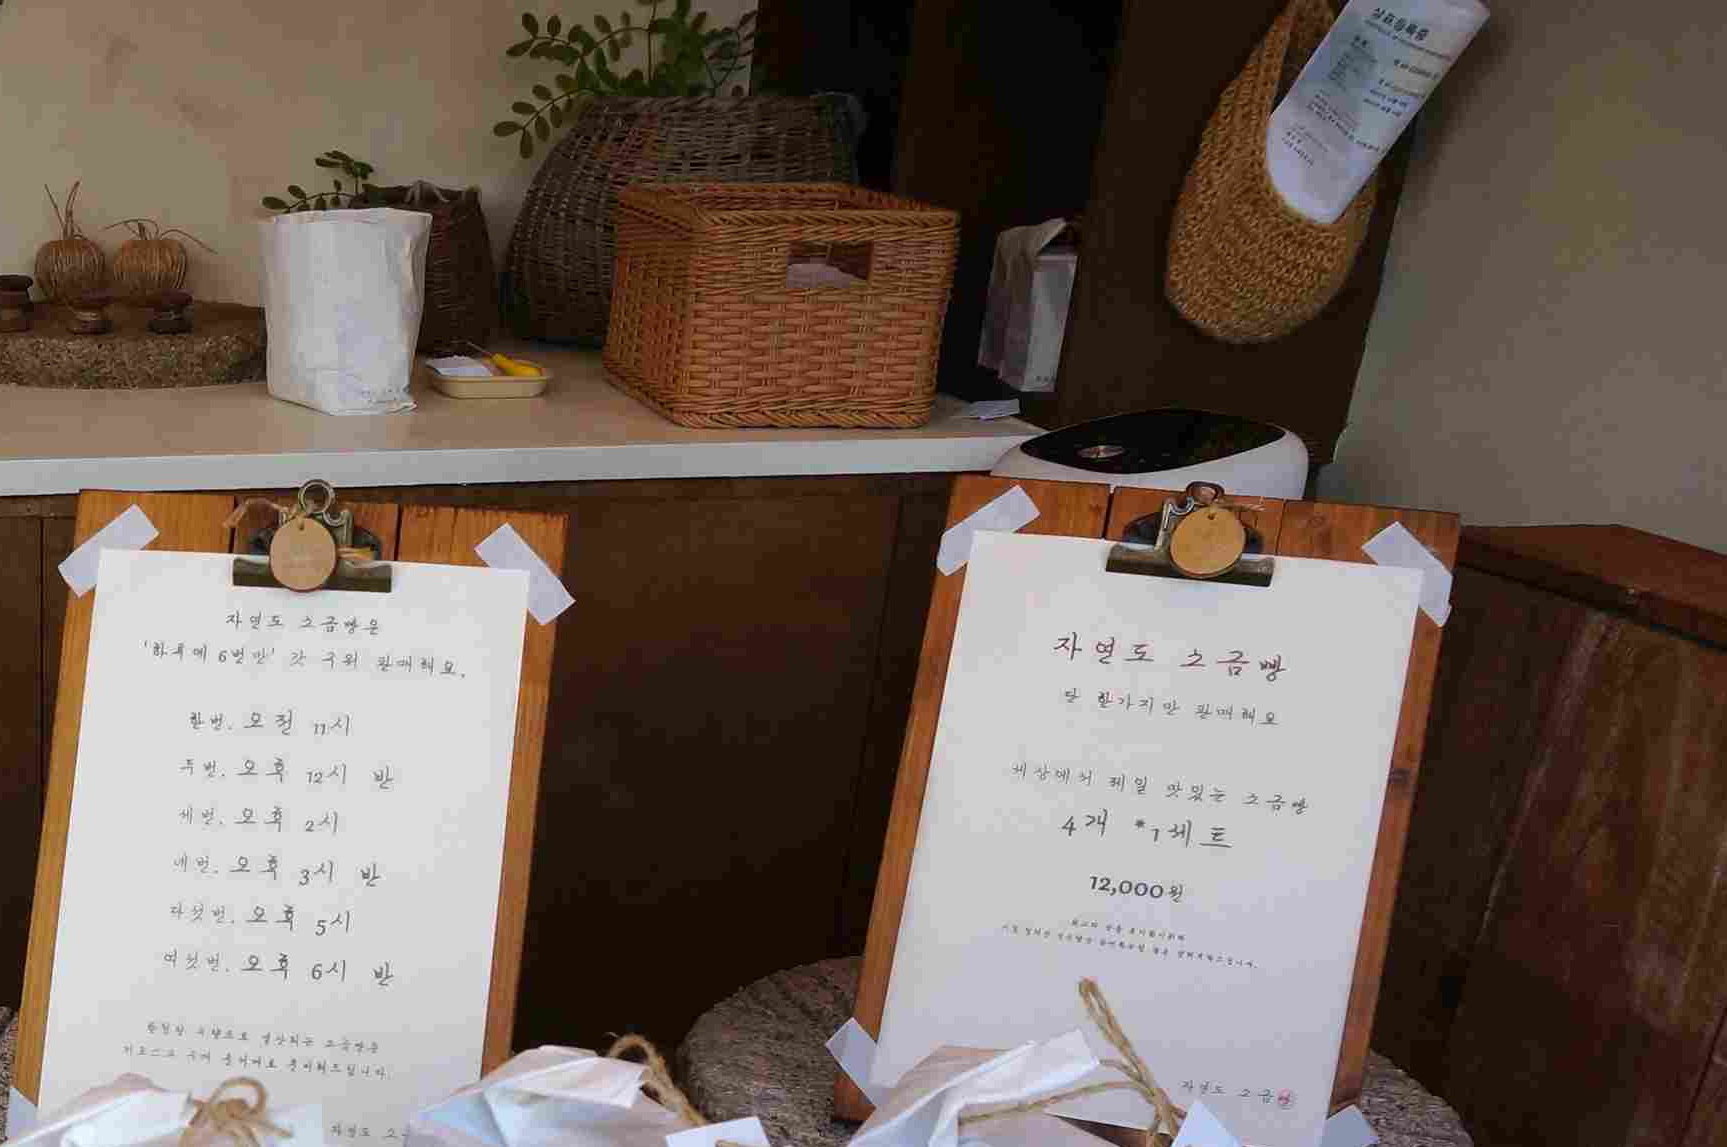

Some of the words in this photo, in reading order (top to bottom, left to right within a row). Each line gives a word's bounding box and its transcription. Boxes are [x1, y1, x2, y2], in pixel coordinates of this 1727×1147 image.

[1054, 632, 1154, 665] 자연도
[1179, 648, 1288, 683] 소금빵
[243, 708, 294, 736] 오전
[1195, 703, 1279, 727] 판매해요
[235, 755, 288, 783] 오후
[306, 762, 347, 785] 12시
[373, 764, 394, 790] 반
[1011, 762, 1092, 787] 세상에서
[1241, 793, 1308, 815] 소금빵
[233, 806, 283, 833] 오후
[305, 810, 338, 836] 2시
[1061, 808, 1108, 837] 4개
[228, 852, 278, 880] 오후
[299, 860, 334, 886] 3시
[359, 861, 381, 888] 반
[1090, 876, 1184, 903] 12,000원
[245, 902, 295, 932] 오후
[314, 909, 351, 936] 5시
[241, 952, 290, 980] 오후
[311, 959, 347, 983] 6시
[372, 961, 394, 988] 반
